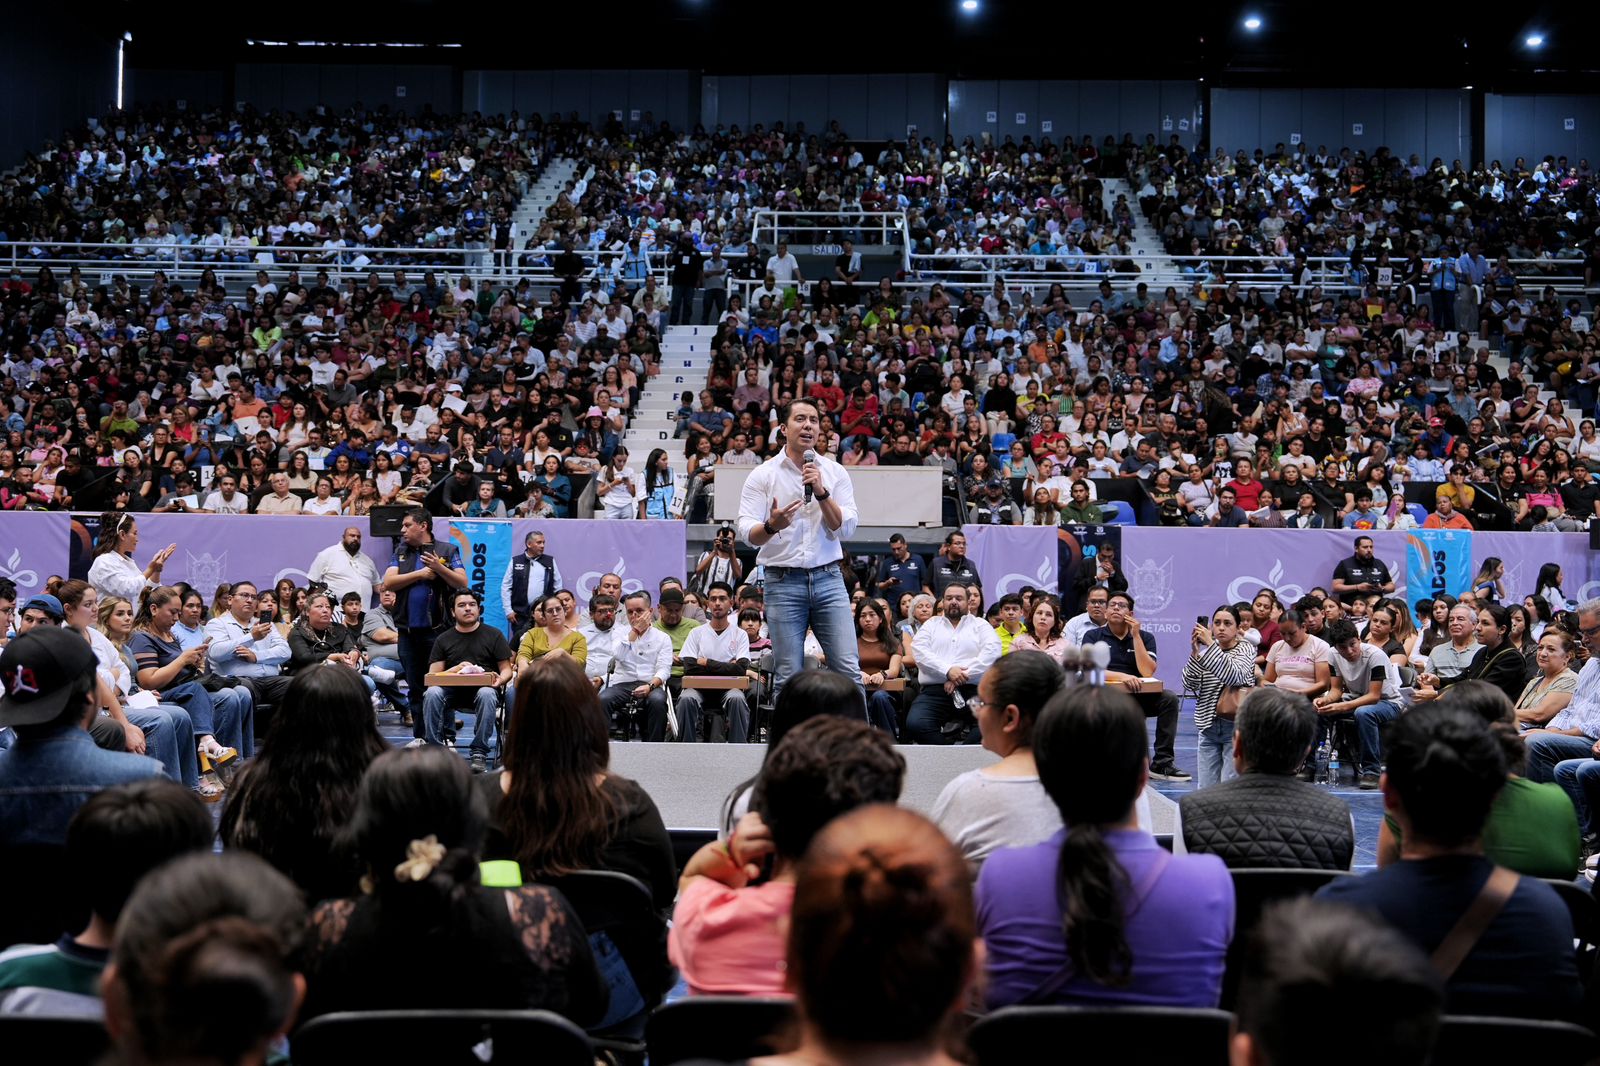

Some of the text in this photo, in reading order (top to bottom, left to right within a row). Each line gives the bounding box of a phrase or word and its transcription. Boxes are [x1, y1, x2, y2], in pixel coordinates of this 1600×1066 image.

[667, 411, 675, 420] E
[659, 431, 668, 440] D
[671, 497, 683, 508] 17
[1139, 622, 1181, 633] RÉTARO
